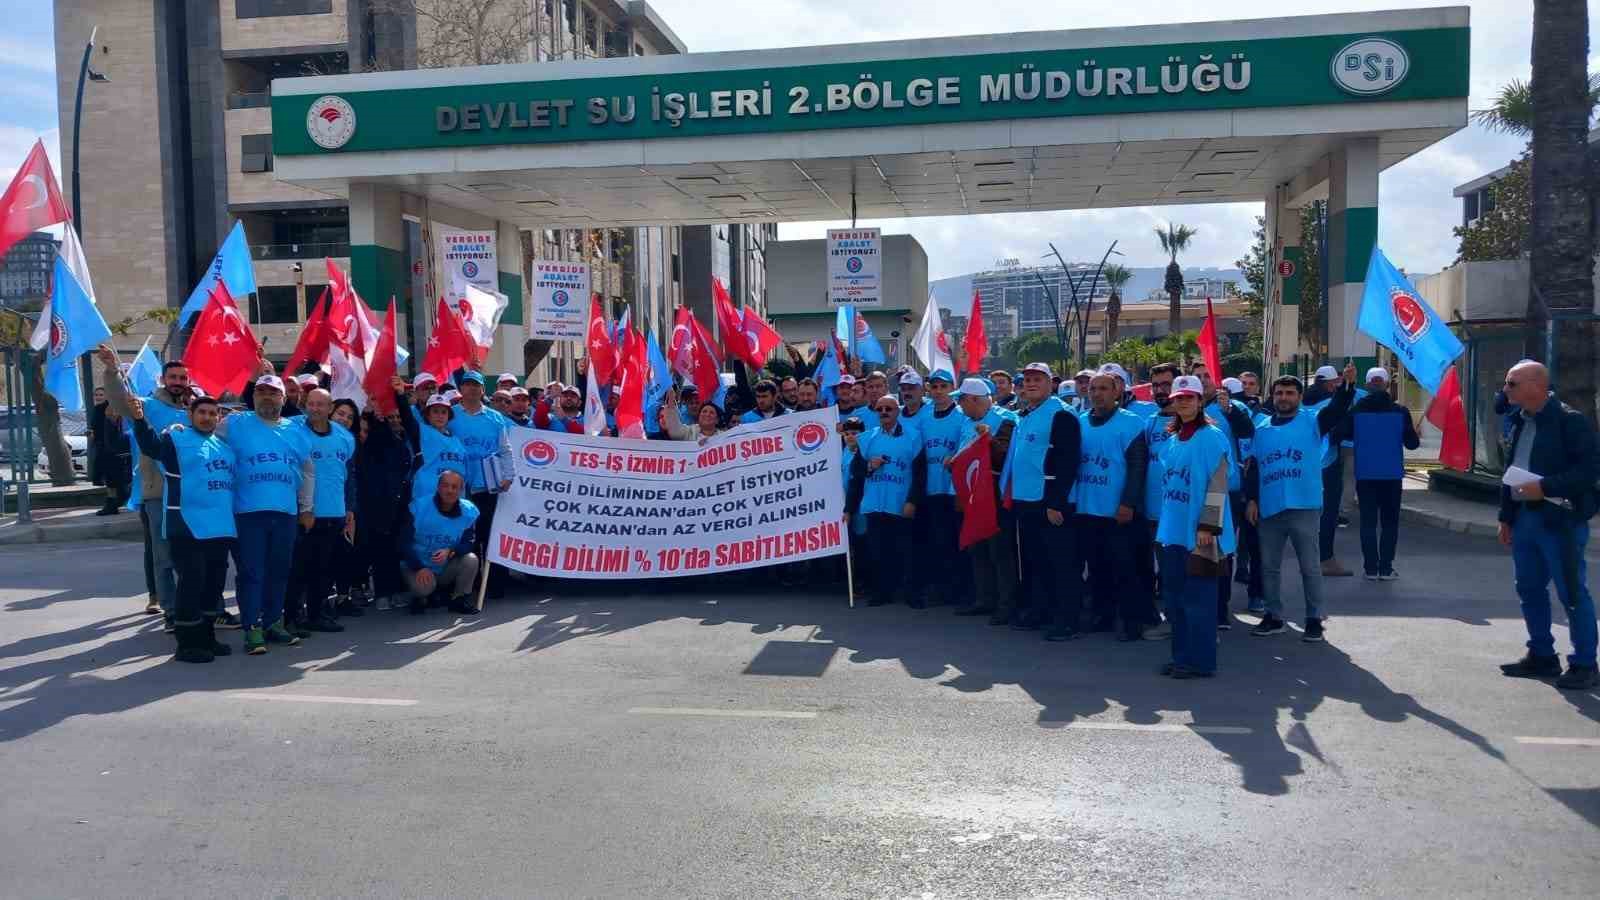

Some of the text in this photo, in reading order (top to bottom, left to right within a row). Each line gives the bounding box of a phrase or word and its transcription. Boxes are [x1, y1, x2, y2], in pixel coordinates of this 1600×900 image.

[436, 53, 1250, 132] DEVLET SU İŞLERİ 2.BÖLGE MÜDÜRLÜĞÜ
[569, 451, 624, 473] TES-İŞ
[626, 454, 675, 475] İZMİR
[740, 436, 784, 461] ŞUBE
[519, 475, 572, 494] VERGİ
[577, 484, 667, 501] DİLİMİNDE
[672, 480, 736, 500] ADALET
[741, 459, 829, 491] İSTİYORUZ
[516, 498, 826, 536] AZ KAZANAN'dan AZ VERGİ ALINSIN
[544, 484, 803, 518] ÇOK KAZANAN'dan ÇOK VERGİ
[499, 520, 841, 573] VERGİ DİLİMİ % 10'da SABİTLENSİN
